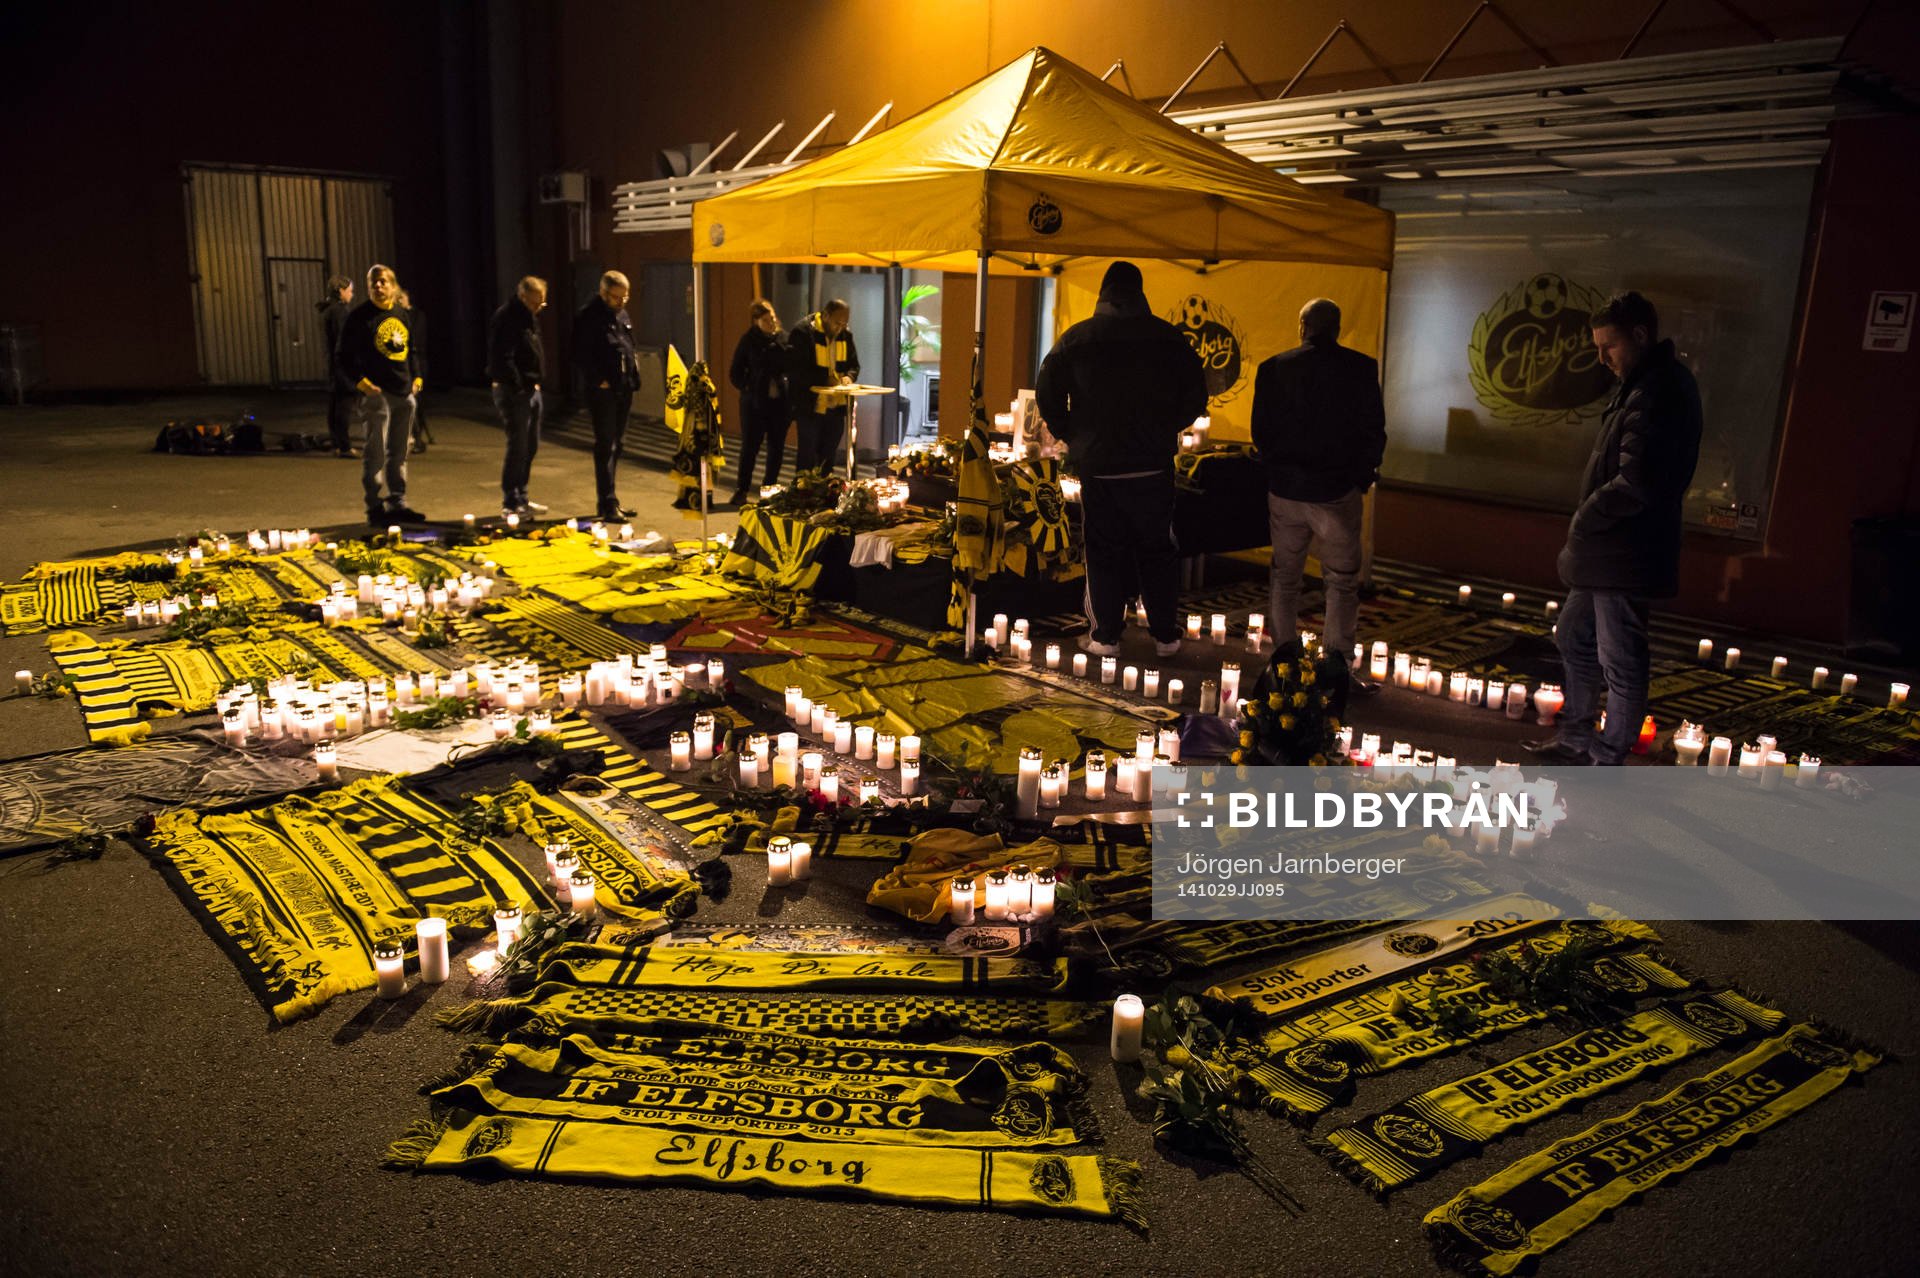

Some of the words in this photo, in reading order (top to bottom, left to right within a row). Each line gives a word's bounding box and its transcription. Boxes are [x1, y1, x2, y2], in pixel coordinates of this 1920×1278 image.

[1456, 910, 1533, 939] 2012
[1240, 967, 1305, 996] Stolt
[1261, 962, 1373, 1008] supporter
[716, 1011, 901, 1029] ELFSBORG
[610, 1071, 721, 1089] REGERANDE
[723, 1079, 806, 1096] SVENSKA
[1456, 1075, 1500, 1106] IF
[1501, 1023, 1652, 1093] ELFSBORG
[557, 1078, 619, 1101] IF
[626, 1083, 926, 1128] ELFSBORG
[1493, 1087, 1546, 1121] STOLT
[1542, 1055, 1642, 1100] SUPPORTER
[618, 1108, 683, 1122] STOLT
[807, 1124, 857, 1137] 2013
[1542, 1161, 1597, 1199] IF
[1590, 1071, 1786, 1175] ELFSBORG
[654, 1133, 873, 1185] Elfsborg
